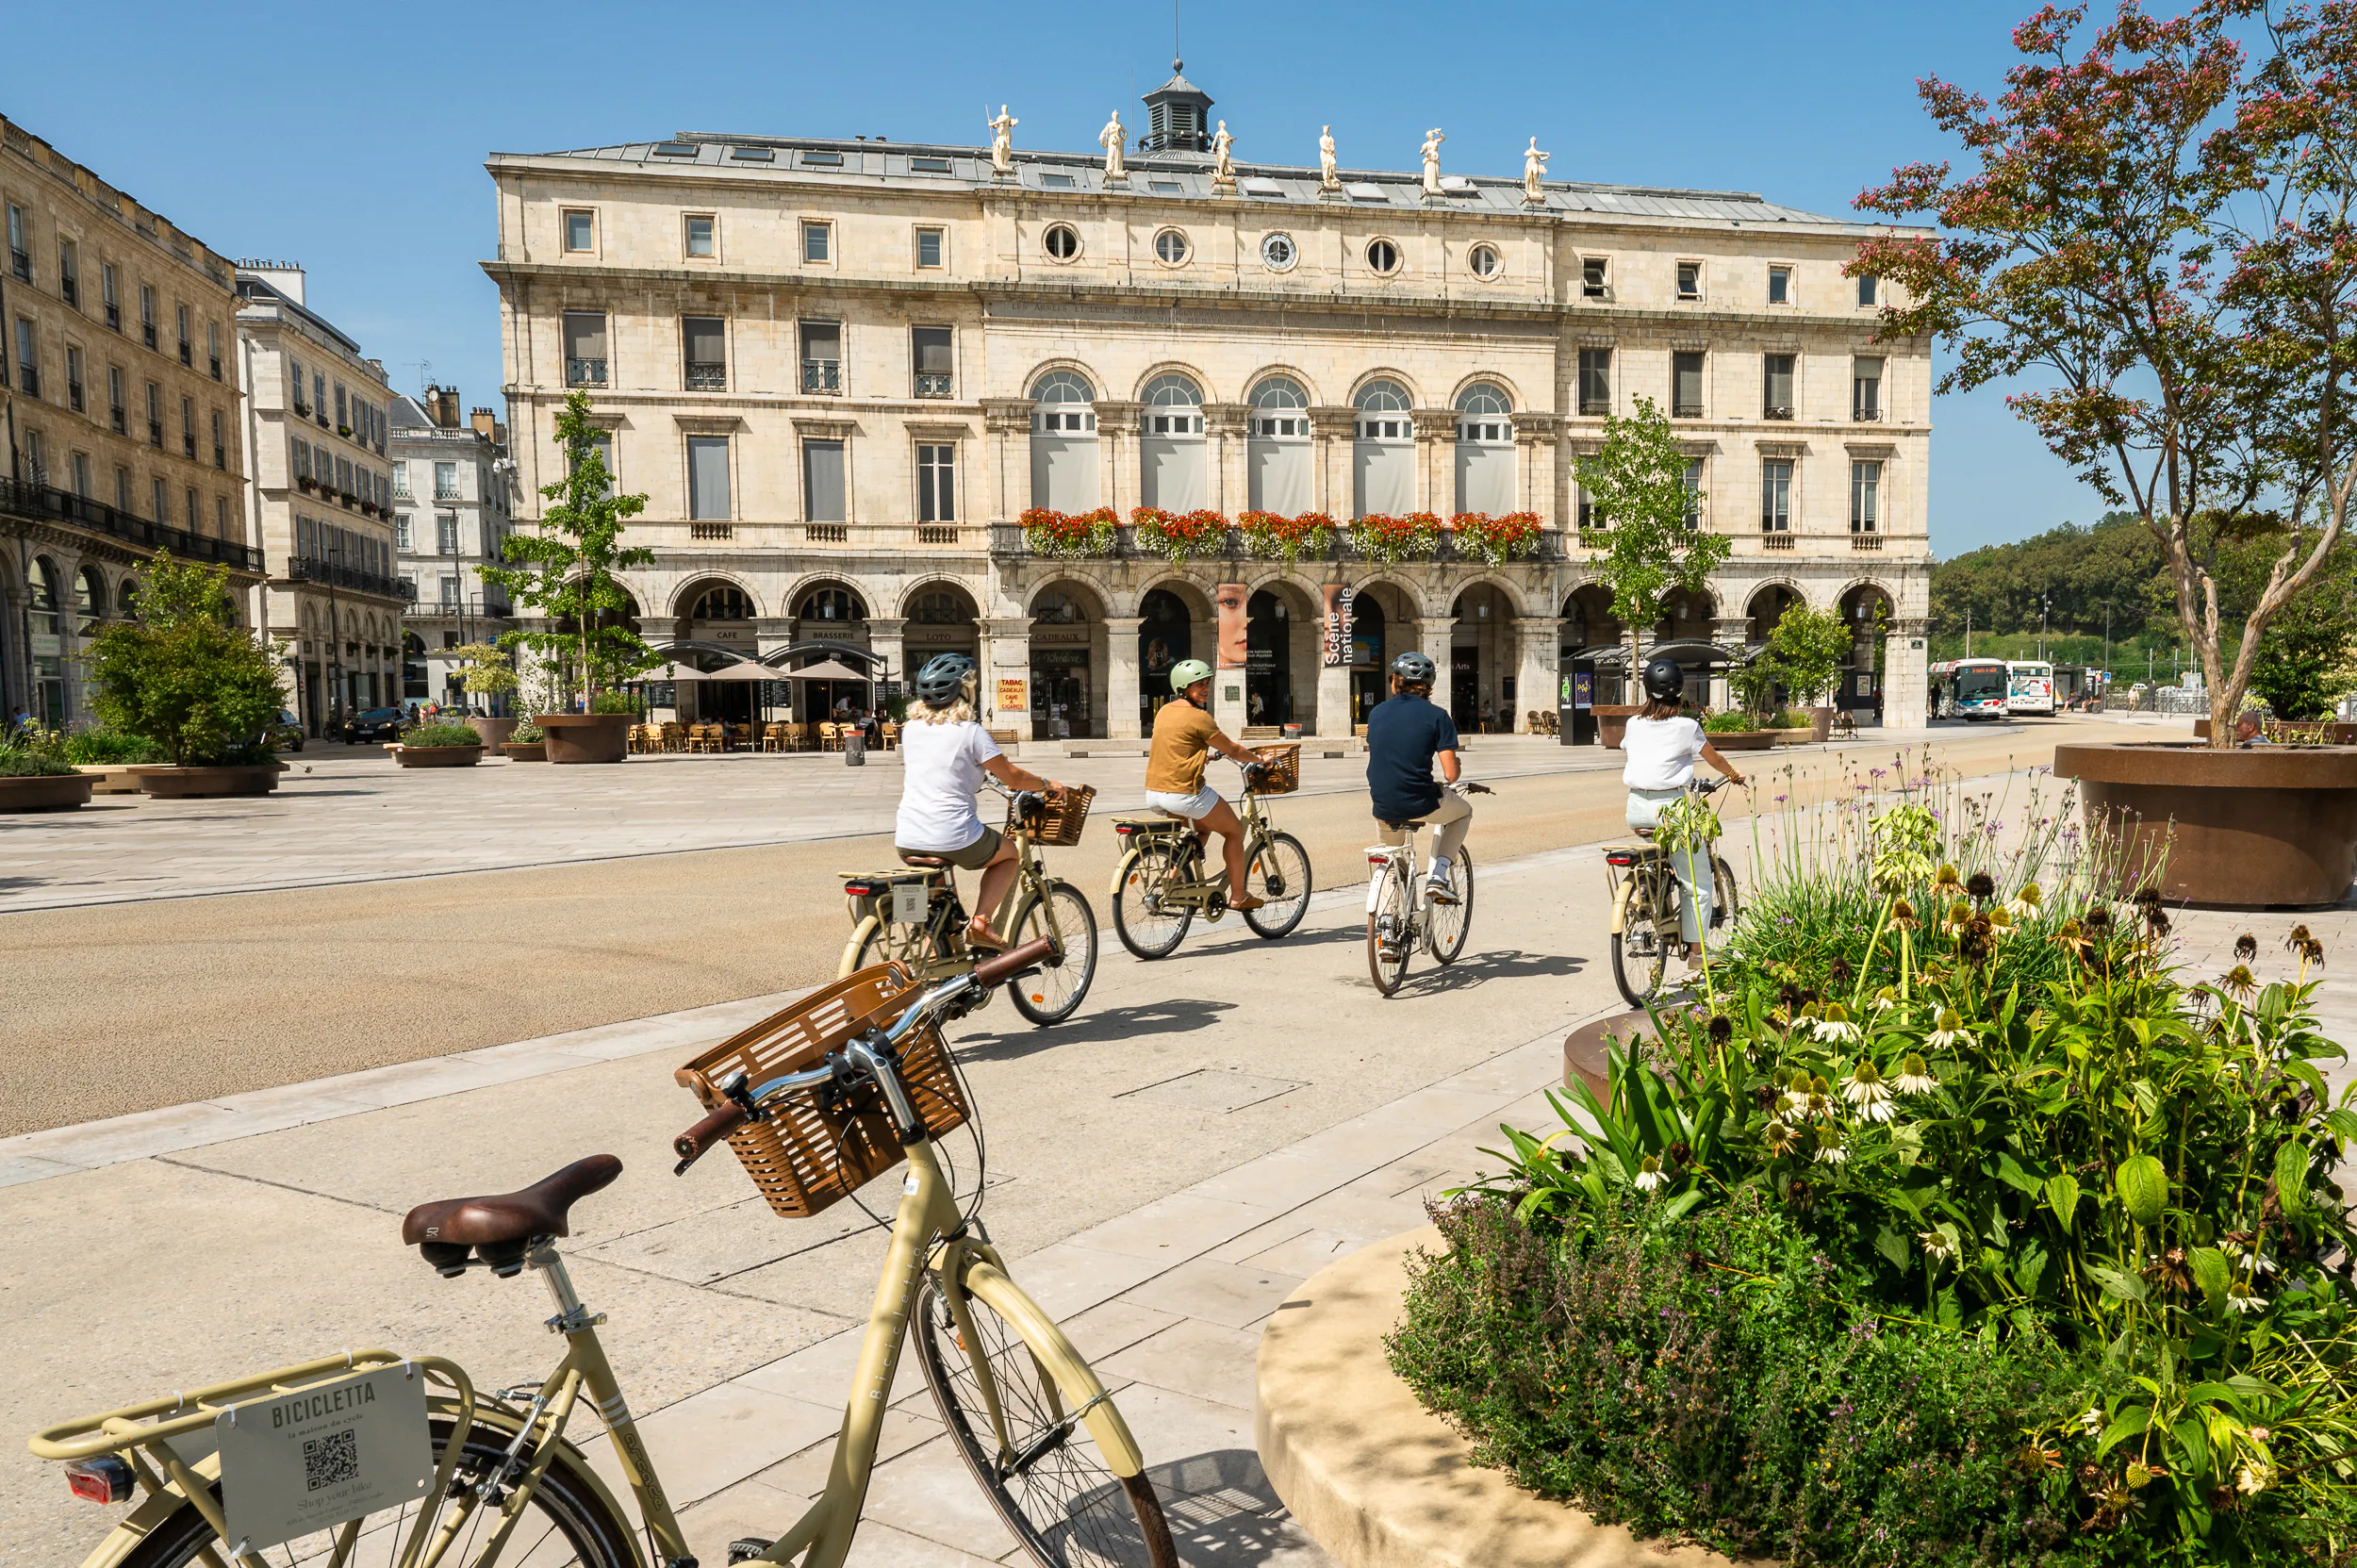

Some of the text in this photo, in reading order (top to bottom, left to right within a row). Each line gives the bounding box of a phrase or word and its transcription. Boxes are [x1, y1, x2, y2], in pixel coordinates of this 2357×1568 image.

[1325, 611, 1339, 664] Scène
[1339, 587, 1352, 663] nationale
[869, 1246, 921, 1401] Bicicletta
[272, 1381, 376, 1429] BICICLETTA
[288, 1413, 365, 1440] la maison du cycle
[297, 1498, 324, 1511] Shop
[326, 1488, 350, 1506] your
[352, 1481, 373, 1494] bike
[624, 1433, 664, 1511] arcade
